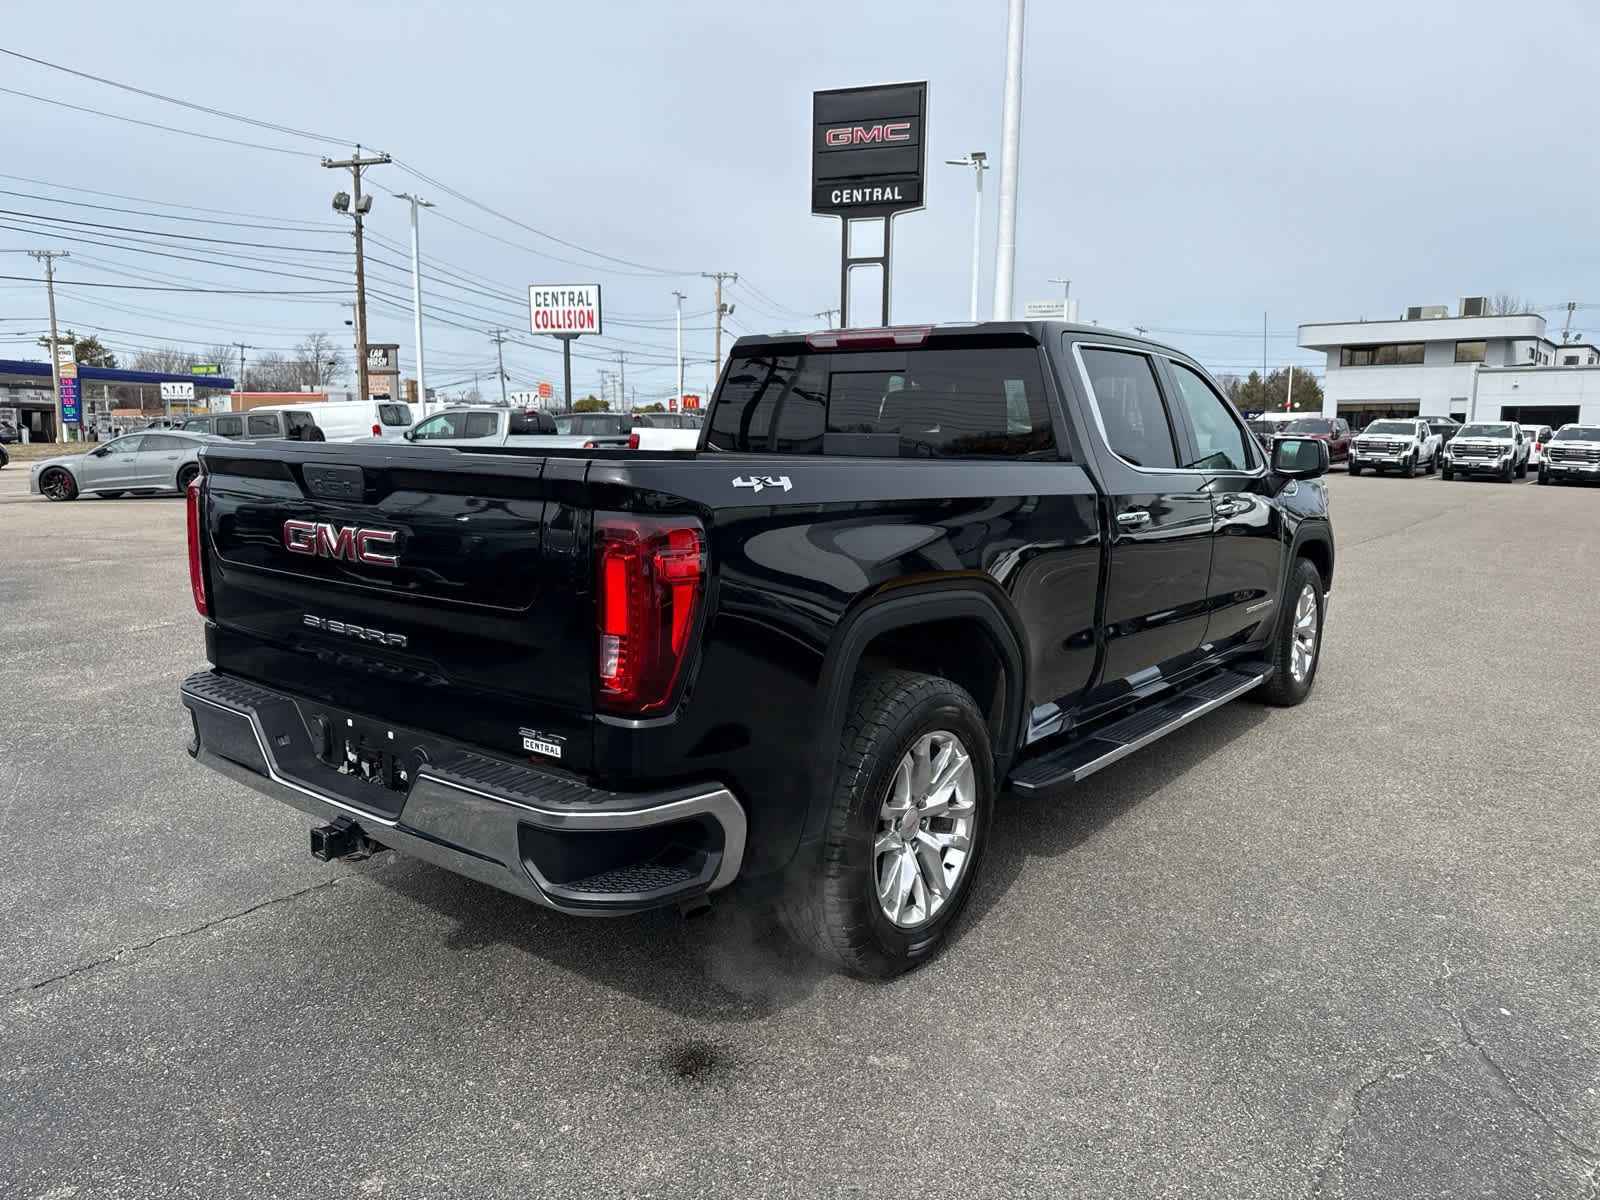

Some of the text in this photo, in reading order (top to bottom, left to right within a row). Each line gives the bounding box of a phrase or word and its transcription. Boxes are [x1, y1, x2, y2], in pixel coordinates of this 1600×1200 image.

[826, 123, 911, 146] GMC
[831, 186, 903, 204] CENTRAL
[535, 291, 593, 307] CENTRAL
[535, 309, 594, 329] COLLISION
[369, 348, 384, 358] CAR
[283, 518, 400, 568] GMC
[302, 613, 408, 648] SIERRA
[518, 726, 568, 745] SLT
[525, 739, 560, 756] CENTRAL
